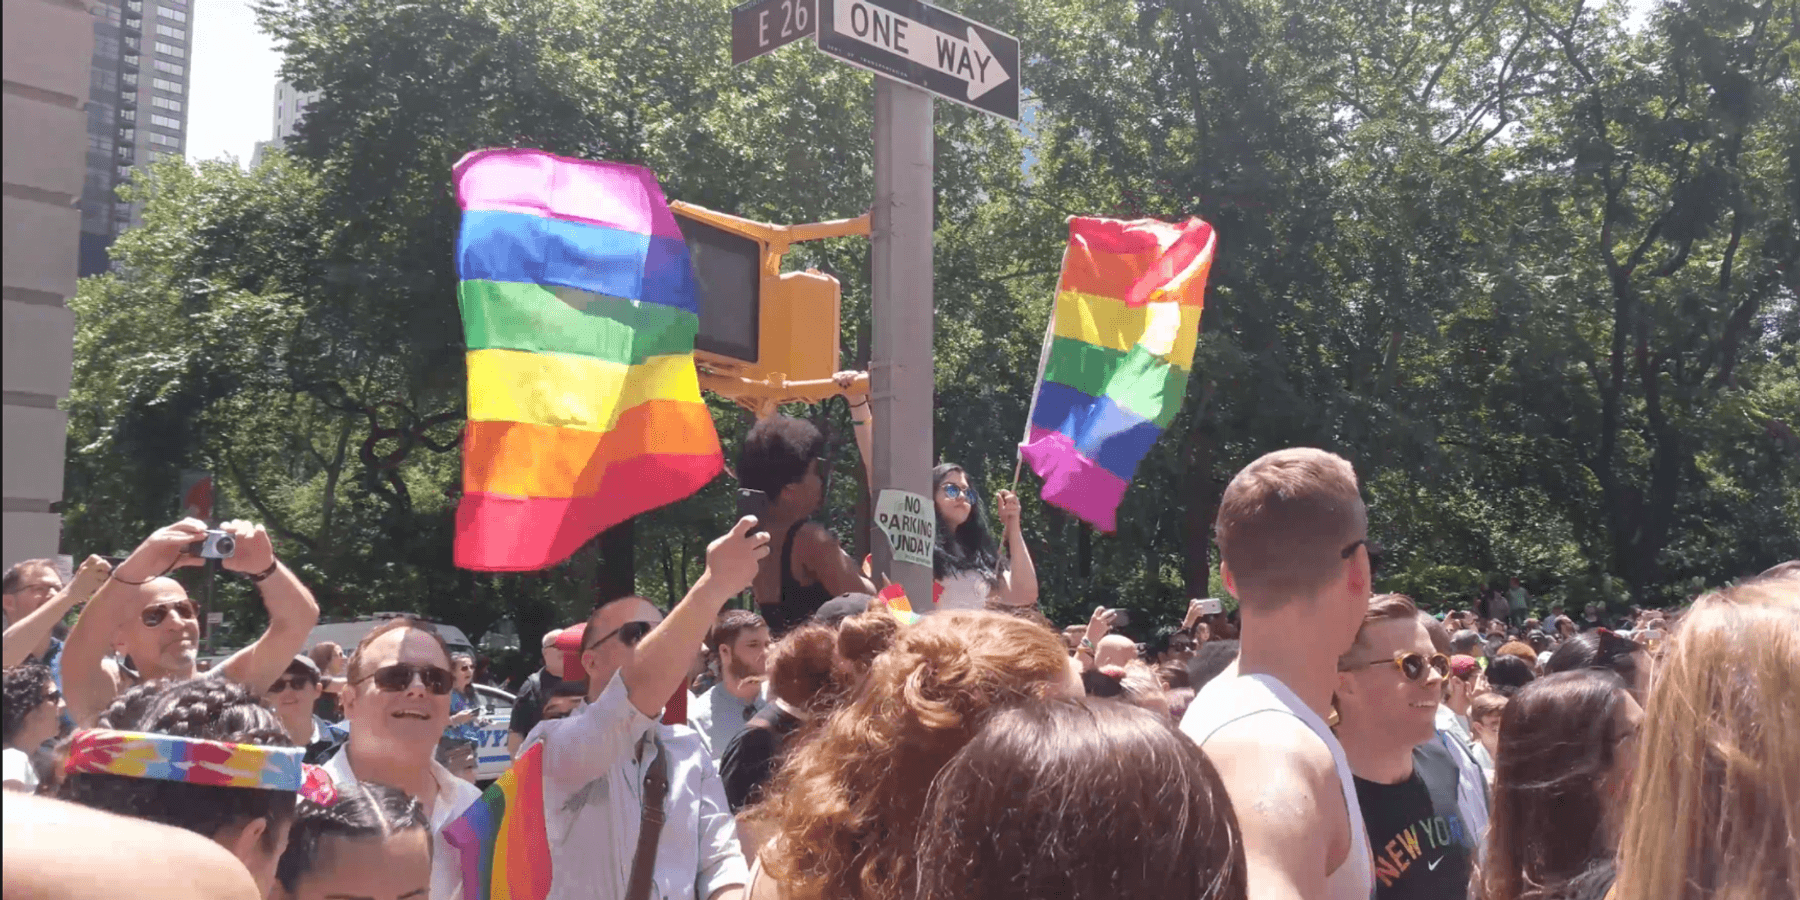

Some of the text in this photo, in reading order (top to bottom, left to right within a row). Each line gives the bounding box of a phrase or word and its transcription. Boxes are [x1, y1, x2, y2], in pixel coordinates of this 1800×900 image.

[759, 0, 808, 47] E 26
[851, 3, 991, 83] ONE WAY
[879, 513, 932, 538] PARKING
[904, 495, 921, 514] NO
[1376, 824, 1422, 887] NEW
